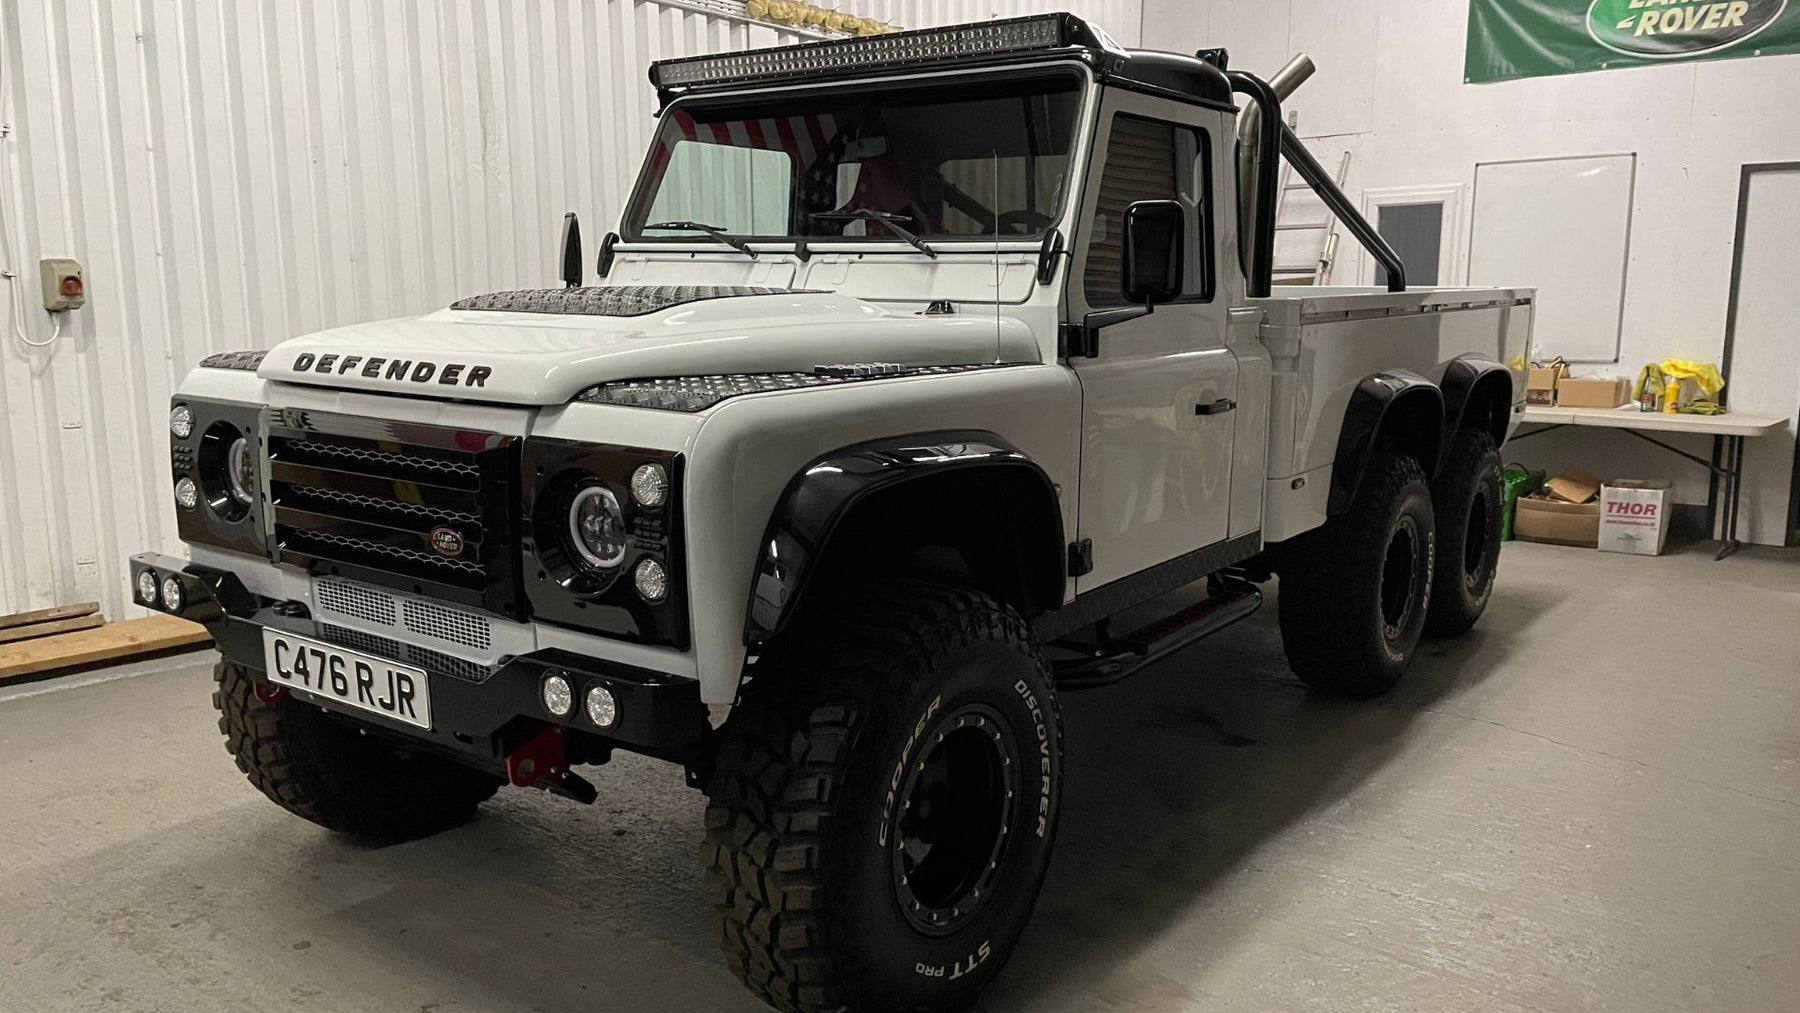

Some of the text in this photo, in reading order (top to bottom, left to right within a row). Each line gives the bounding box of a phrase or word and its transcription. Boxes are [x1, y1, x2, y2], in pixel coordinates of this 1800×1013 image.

[1633, 1, 1749, 37] ROVER
[293, 352, 492, 388] DEFENDER
[1606, 501, 1657, 516] THOR
[274, 638, 417, 719] C476 RJR
[877, 695, 941, 847] COOPER
[1014, 679, 1051, 838] DISCOVERER
[915, 940, 991, 980] STT PRO
